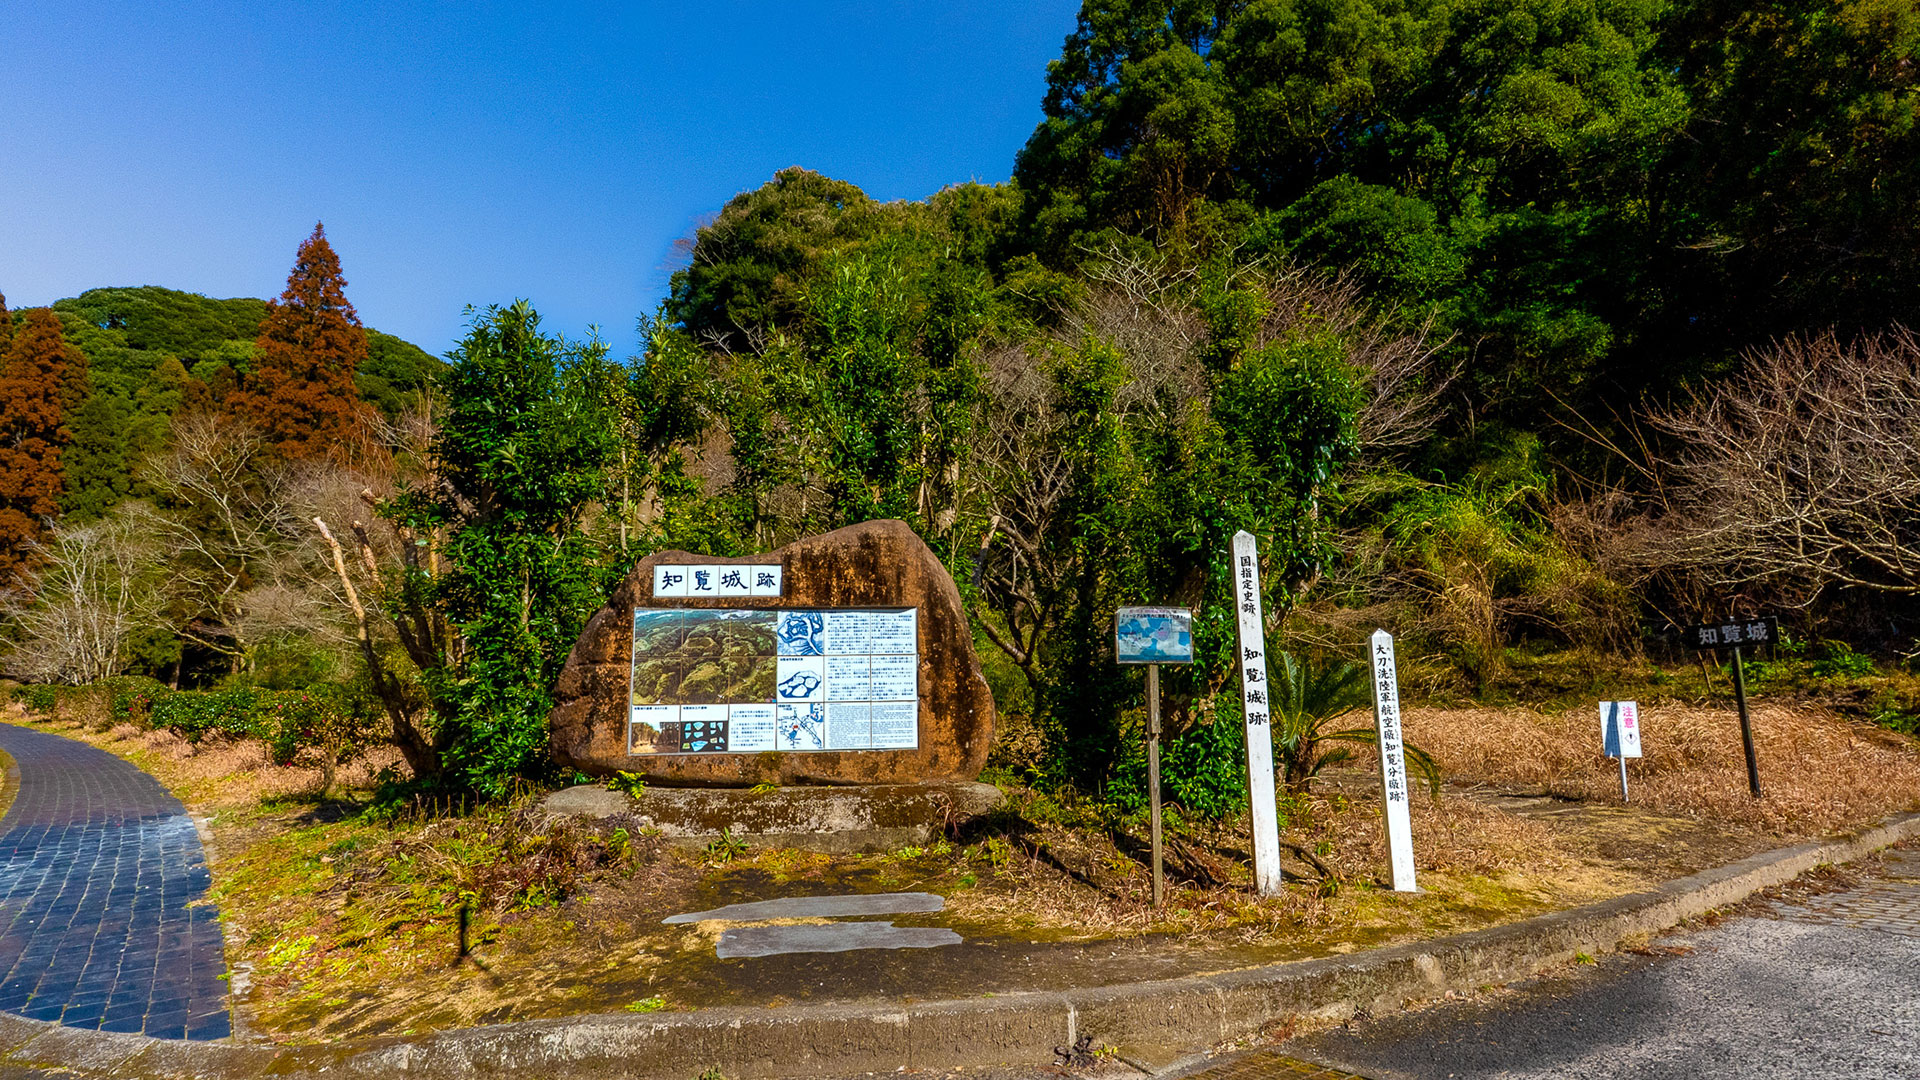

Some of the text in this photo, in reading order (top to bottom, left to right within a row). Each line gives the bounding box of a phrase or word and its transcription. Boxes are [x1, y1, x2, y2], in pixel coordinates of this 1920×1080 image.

[661, 570, 776, 592] 知覧城跡
[1240, 556, 1262, 726] 国指定史跡 知覧城跡
[1698, 622, 1769, 646] 知覧城
[1622, 706, 1635, 729] 注意
